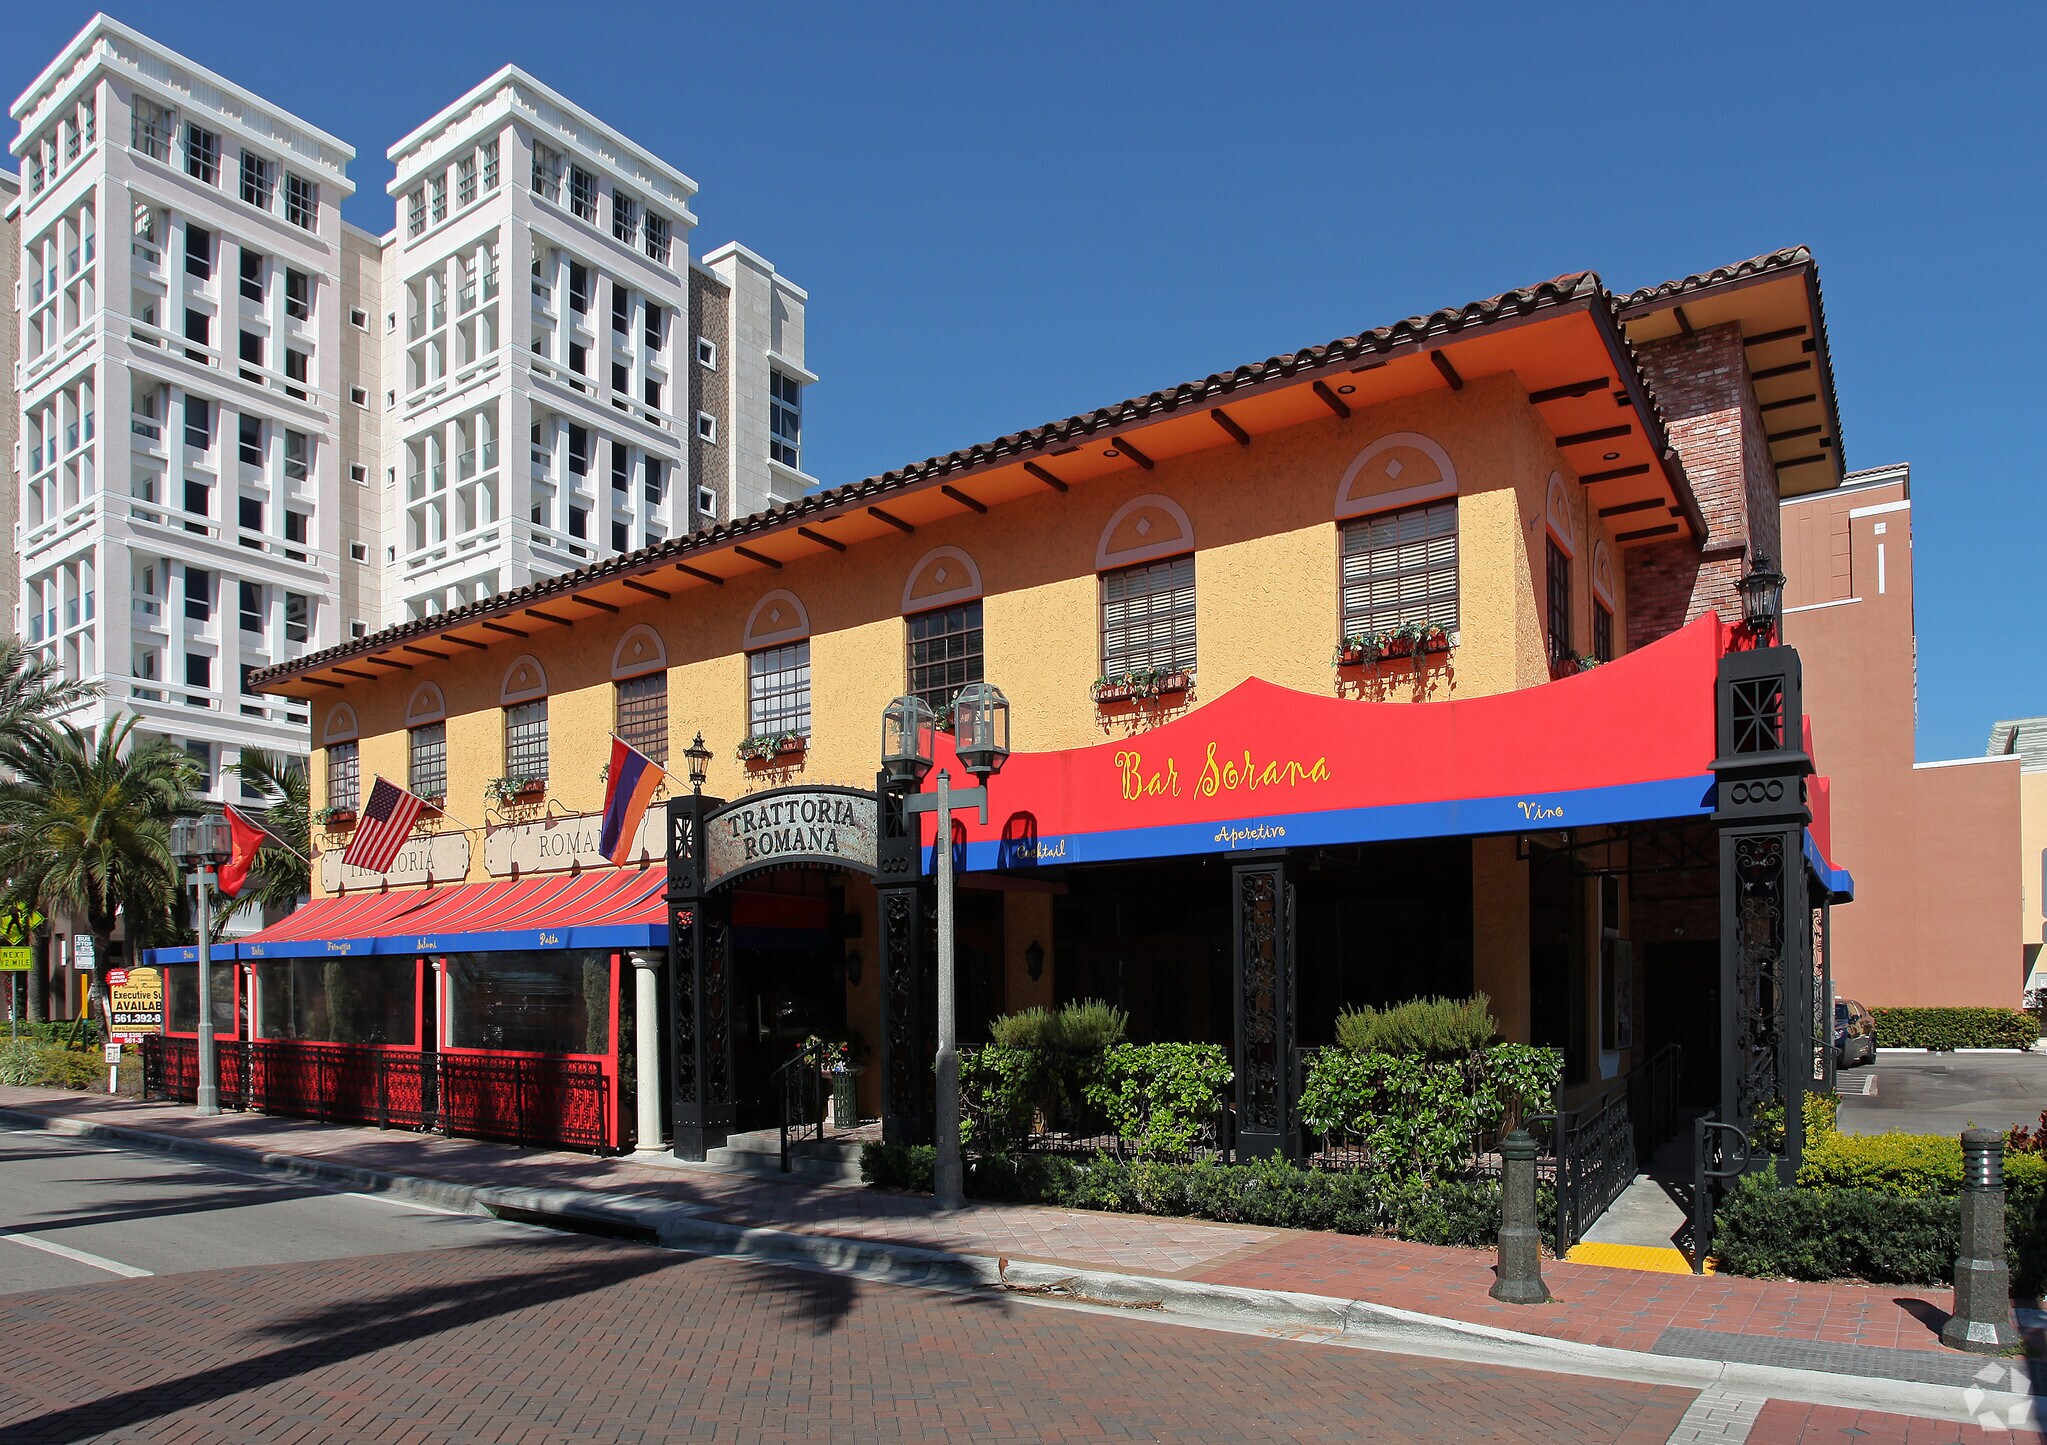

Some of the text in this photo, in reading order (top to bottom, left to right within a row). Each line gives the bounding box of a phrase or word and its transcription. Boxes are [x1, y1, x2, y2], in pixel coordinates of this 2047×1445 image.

[1114, 741, 1332, 801] Bar Sorana
[727, 799, 856, 838] TRATTORIA
[1517, 801, 1564, 820] Vino
[743, 827, 840, 860] ROMANA
[1214, 823, 1286, 849] Aperetivo
[1017, 839, 1067, 859] Cocktail
[539, 932, 559, 945] Pasta
[114, 991, 151, 999] Executive
[115, 1014, 161, 1023] 561.392-8
